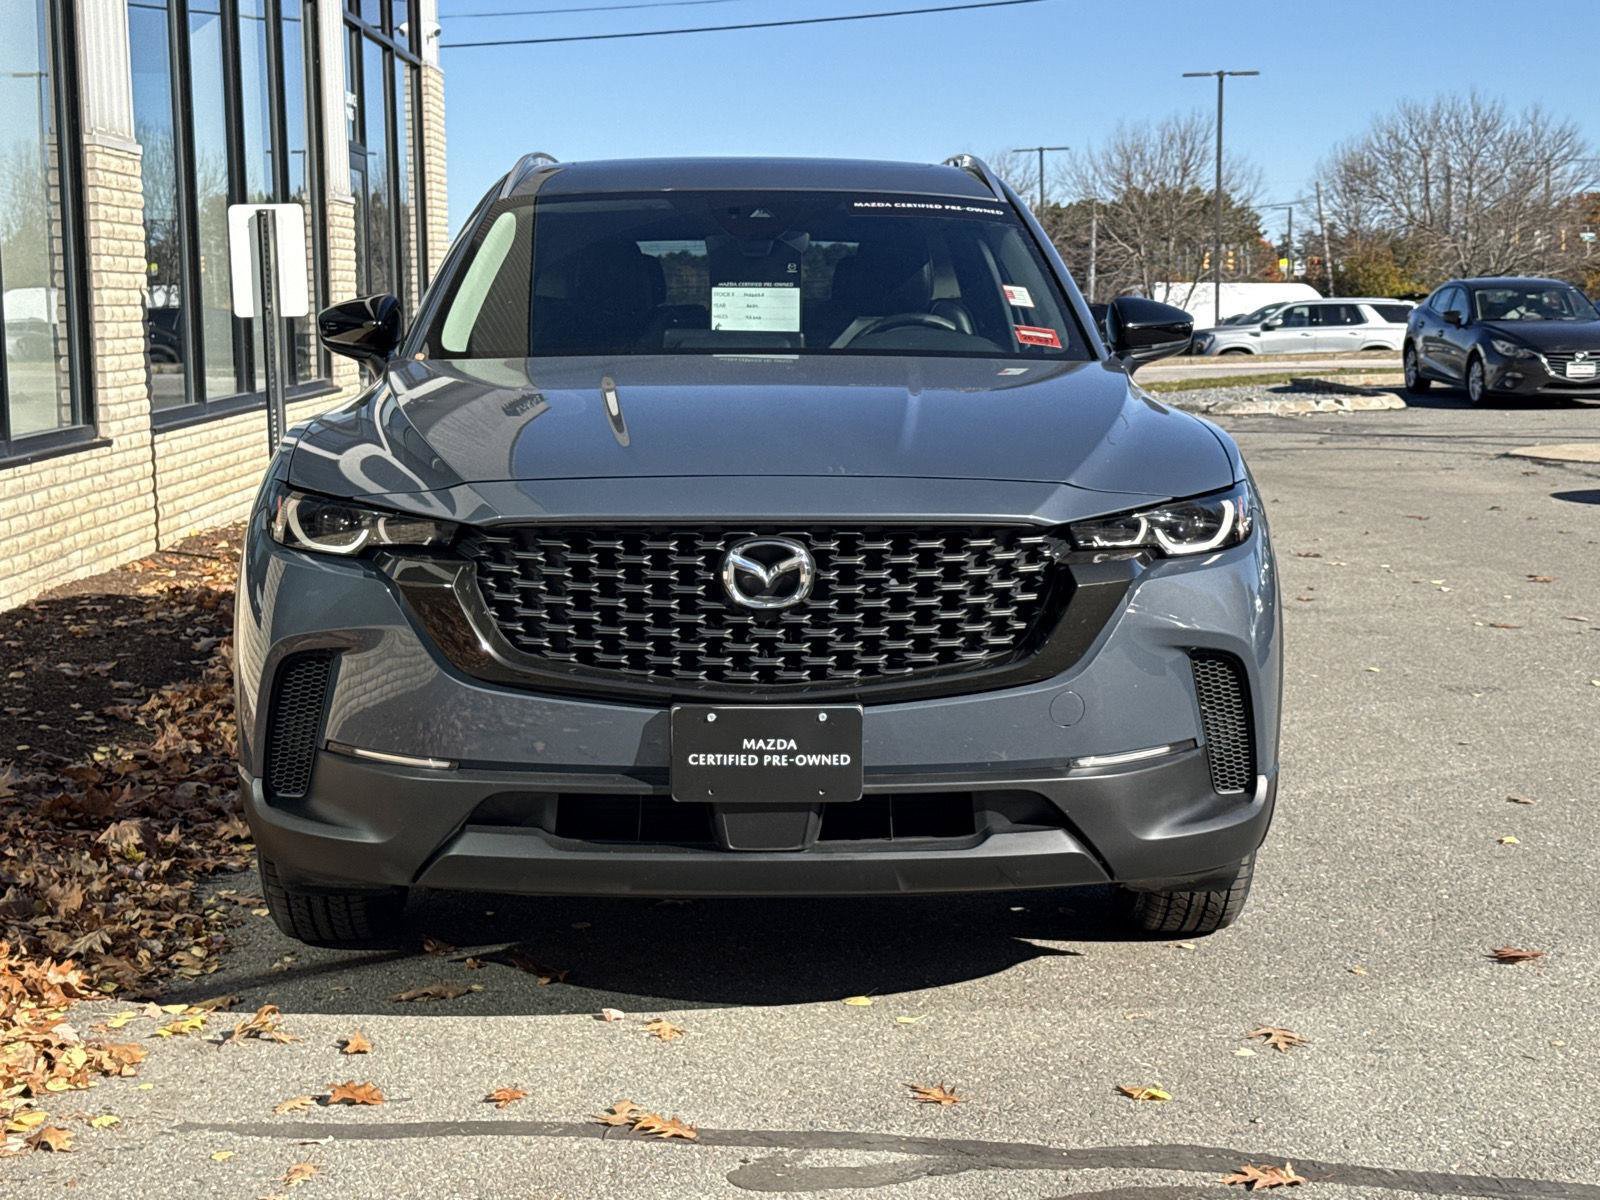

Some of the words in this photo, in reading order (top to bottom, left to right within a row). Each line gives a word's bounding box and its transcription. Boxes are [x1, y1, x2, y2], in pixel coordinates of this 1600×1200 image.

[894, 201, 943, 210] CERTIFIED
[944, 204, 1005, 216] PRE-OWNED
[742, 738, 798, 751] MAZDA
[688, 754, 759, 766] CERTIFIED
[763, 754, 851, 767] PRE-OWNED
